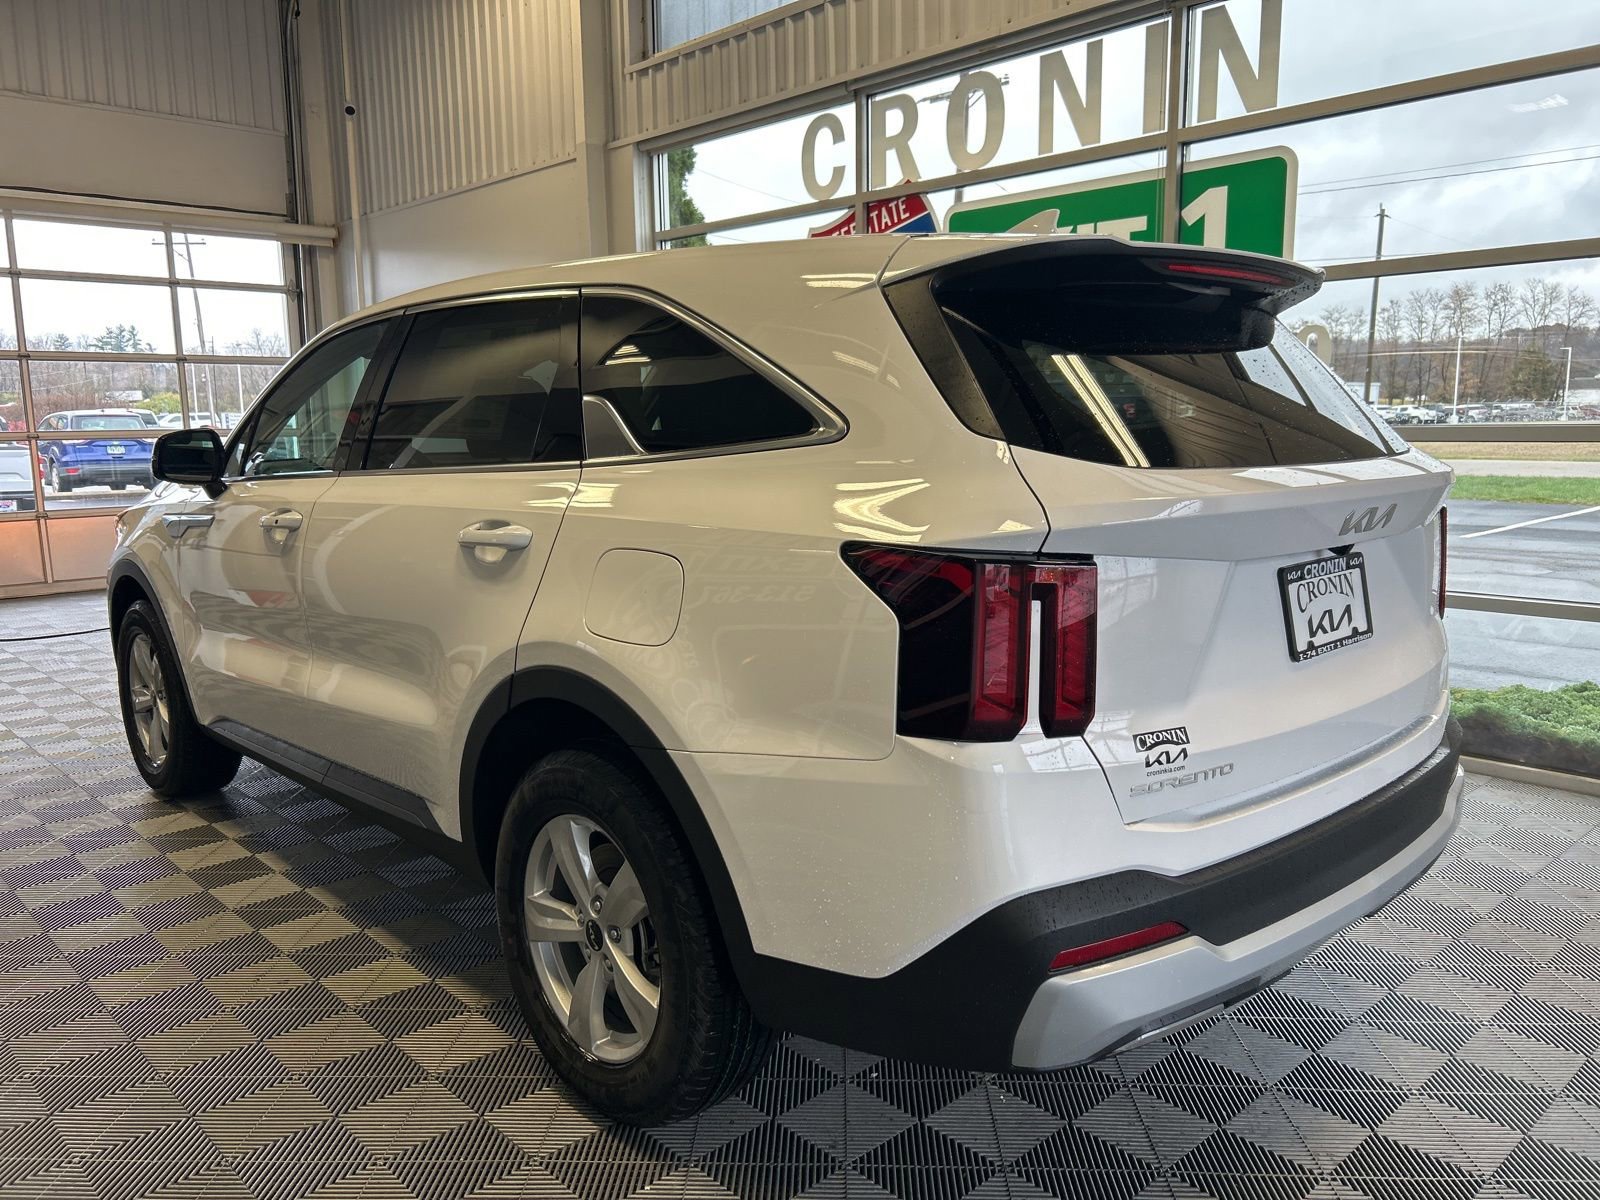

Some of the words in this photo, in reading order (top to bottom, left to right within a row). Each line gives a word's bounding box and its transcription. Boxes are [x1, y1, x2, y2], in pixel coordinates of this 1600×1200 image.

[801, 0, 1282, 200] CRONIN
[1338, 503, 1398, 536] KIA
[1304, 557, 1347, 579] CRONIN
[1297, 571, 1355, 613] CRONIN
[1308, 604, 1353, 639] KIA
[1299, 649, 1316, 660] I-74
[1317, 643, 1335, 655] EXIT
[1343, 632, 1373, 646] Harrison
[1136, 728, 1188, 751] CRONIN
[1145, 747, 1188, 768] KIA
[1146, 765, 1186, 777] croninkia.com
[1129, 762, 1234, 797] SORENTO
